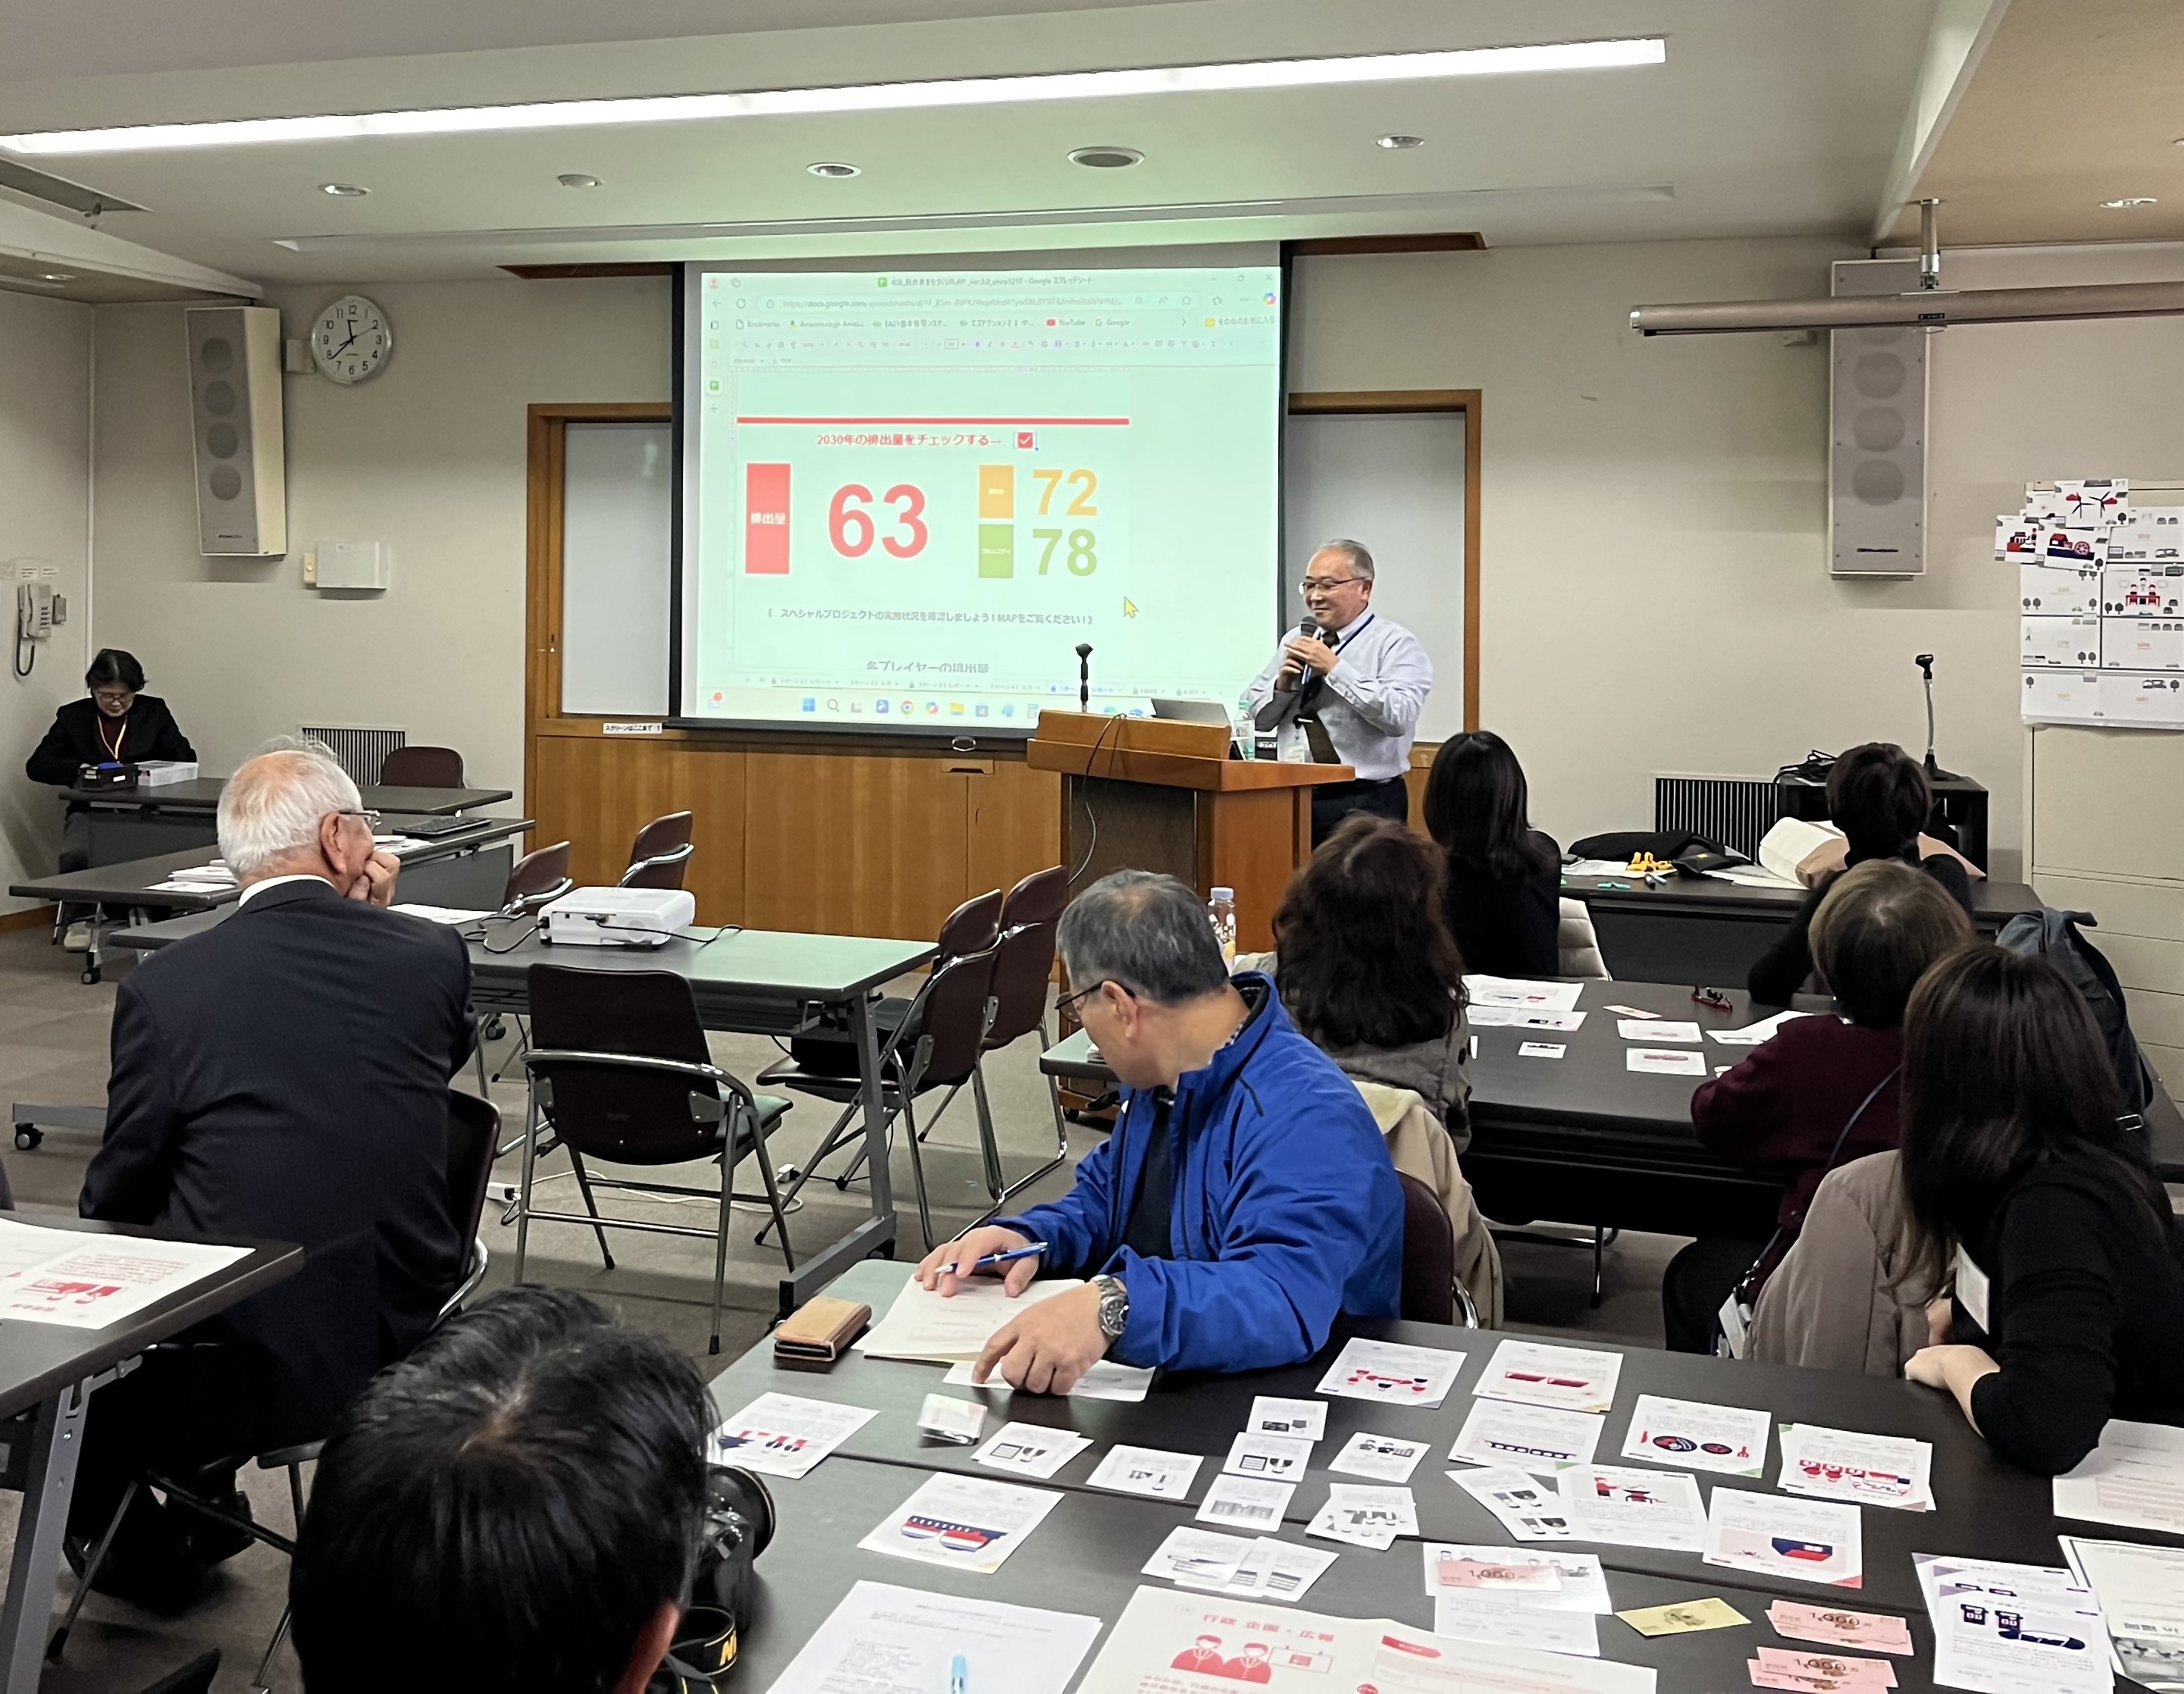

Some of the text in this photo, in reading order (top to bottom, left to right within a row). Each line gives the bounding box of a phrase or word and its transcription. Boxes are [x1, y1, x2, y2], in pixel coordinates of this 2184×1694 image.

[337, 308, 343, 318] 11
[349, 305, 357, 315] 12
[326, 321, 334, 330] 10
[372, 320, 378, 329] 2
[1107, 318, 1130, 327] Google
[323, 335, 329, 345] 9
[376, 335, 382, 345] 3
[327, 350, 332, 359] 8
[372, 349, 378, 359] 4
[336, 361, 342, 370] 7
[349, 365, 355, 374] 6
[362, 361, 368, 371] 5
[1032, 468, 1098, 516] 72
[829, 483, 929, 559] 63
[1032, 528, 1098, 577] 78
